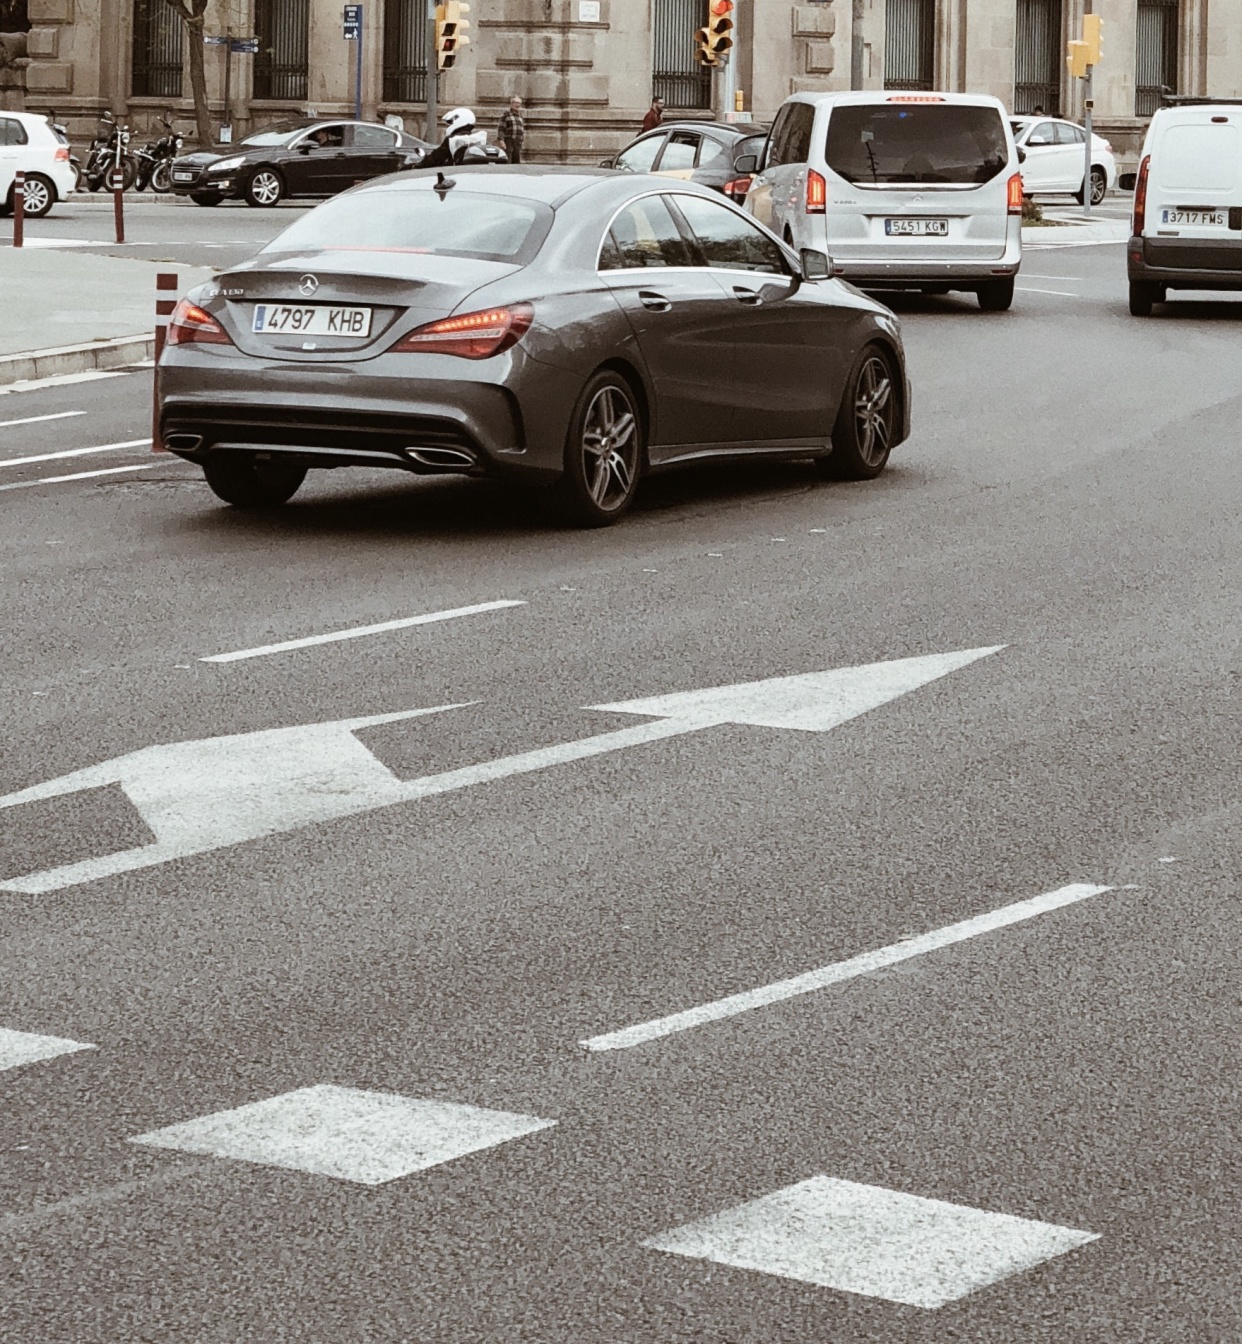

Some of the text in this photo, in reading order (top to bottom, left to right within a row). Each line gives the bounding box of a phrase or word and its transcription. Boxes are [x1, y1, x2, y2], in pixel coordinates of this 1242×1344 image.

[1170, 212, 1224, 225] 3717 FMS
[893, 221, 946, 232] 5451 KGW
[268, 308, 365, 333] 4797 KHB
